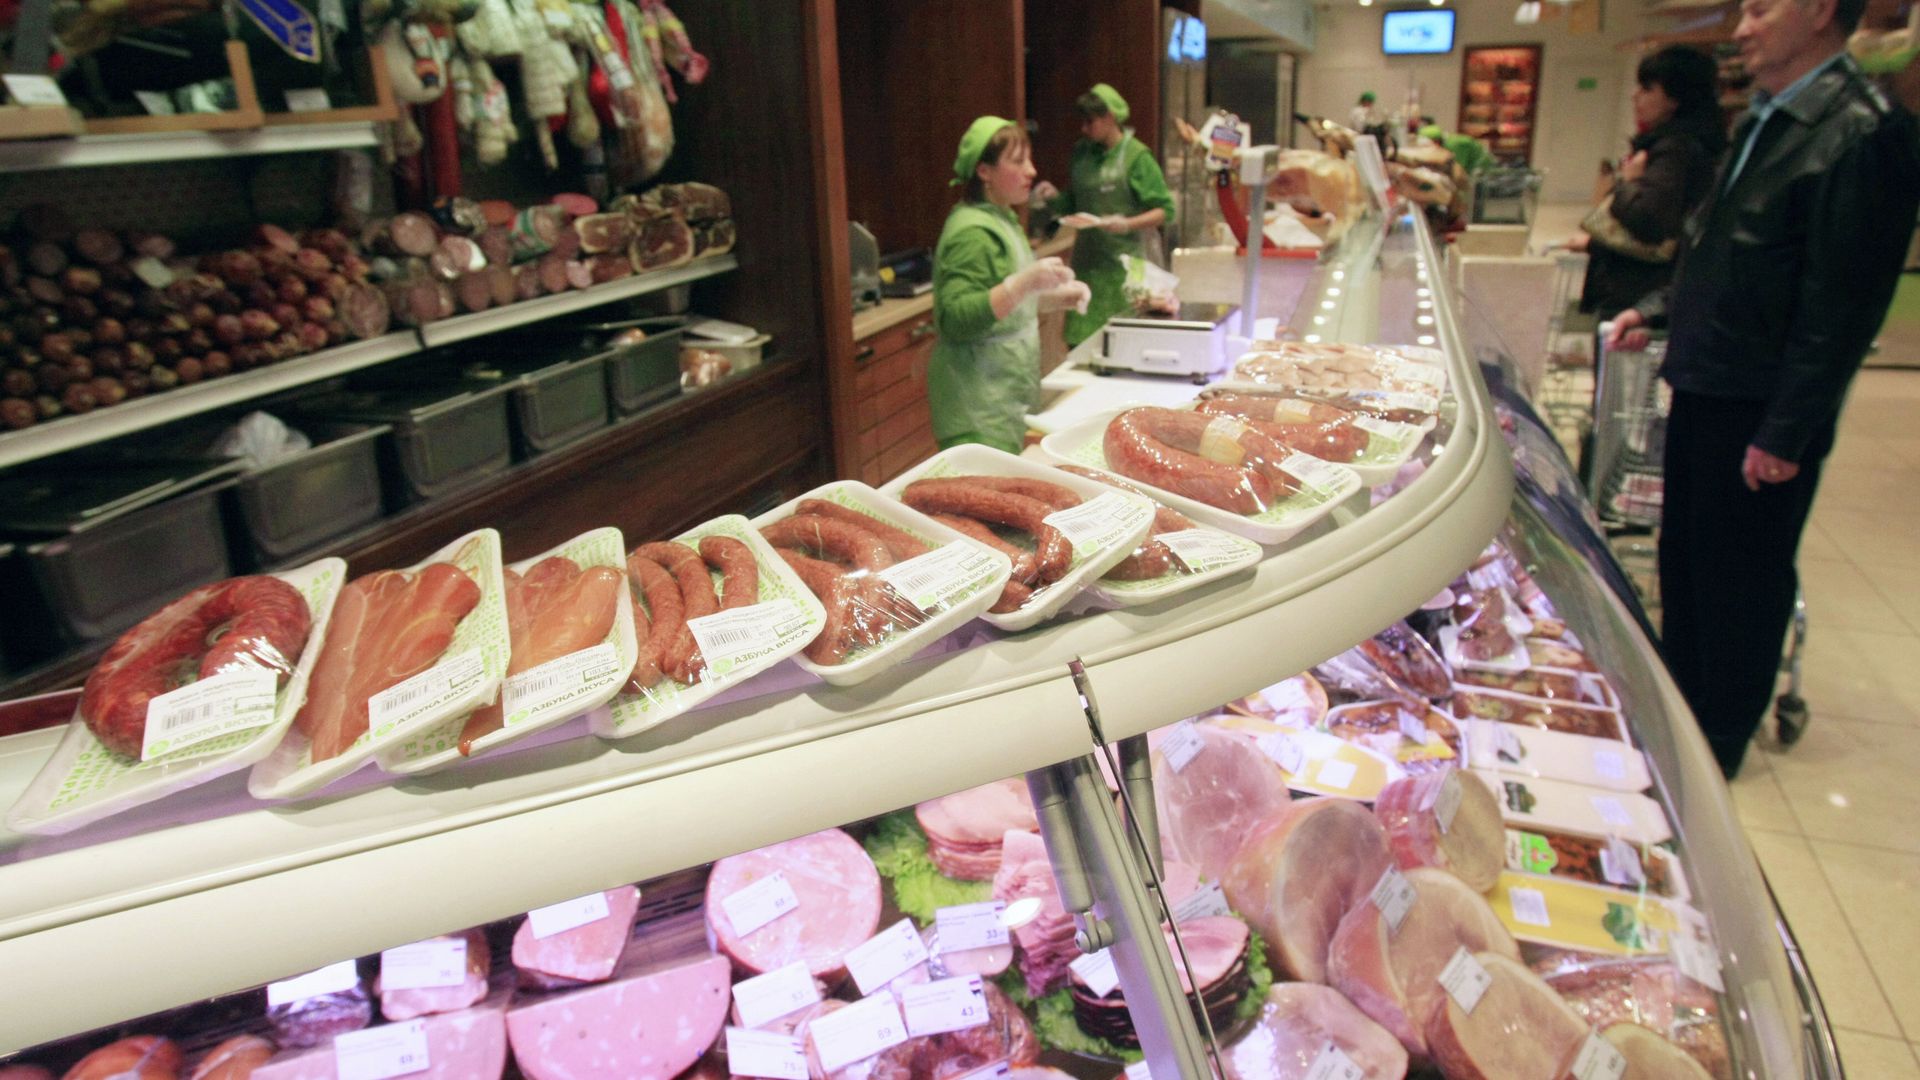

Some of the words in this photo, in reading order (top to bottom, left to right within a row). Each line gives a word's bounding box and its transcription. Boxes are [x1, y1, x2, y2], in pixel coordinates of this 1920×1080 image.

[935, 577, 968, 598] АЗБУКА
[968, 562, 997, 583] ВКУСА
[734, 646, 775, 665] АЗБУКА
[775, 628, 809, 650] ВКУСА
[396, 699, 442, 726] АЗБУКА
[443, 678, 481, 701] ВКУСА
[530, 691, 575, 715] АЗБУКА
[577, 676, 616, 695] ВКУСА
[173, 723, 221, 747] АЗБУКА
[223, 713, 268, 729] ВКУСА
